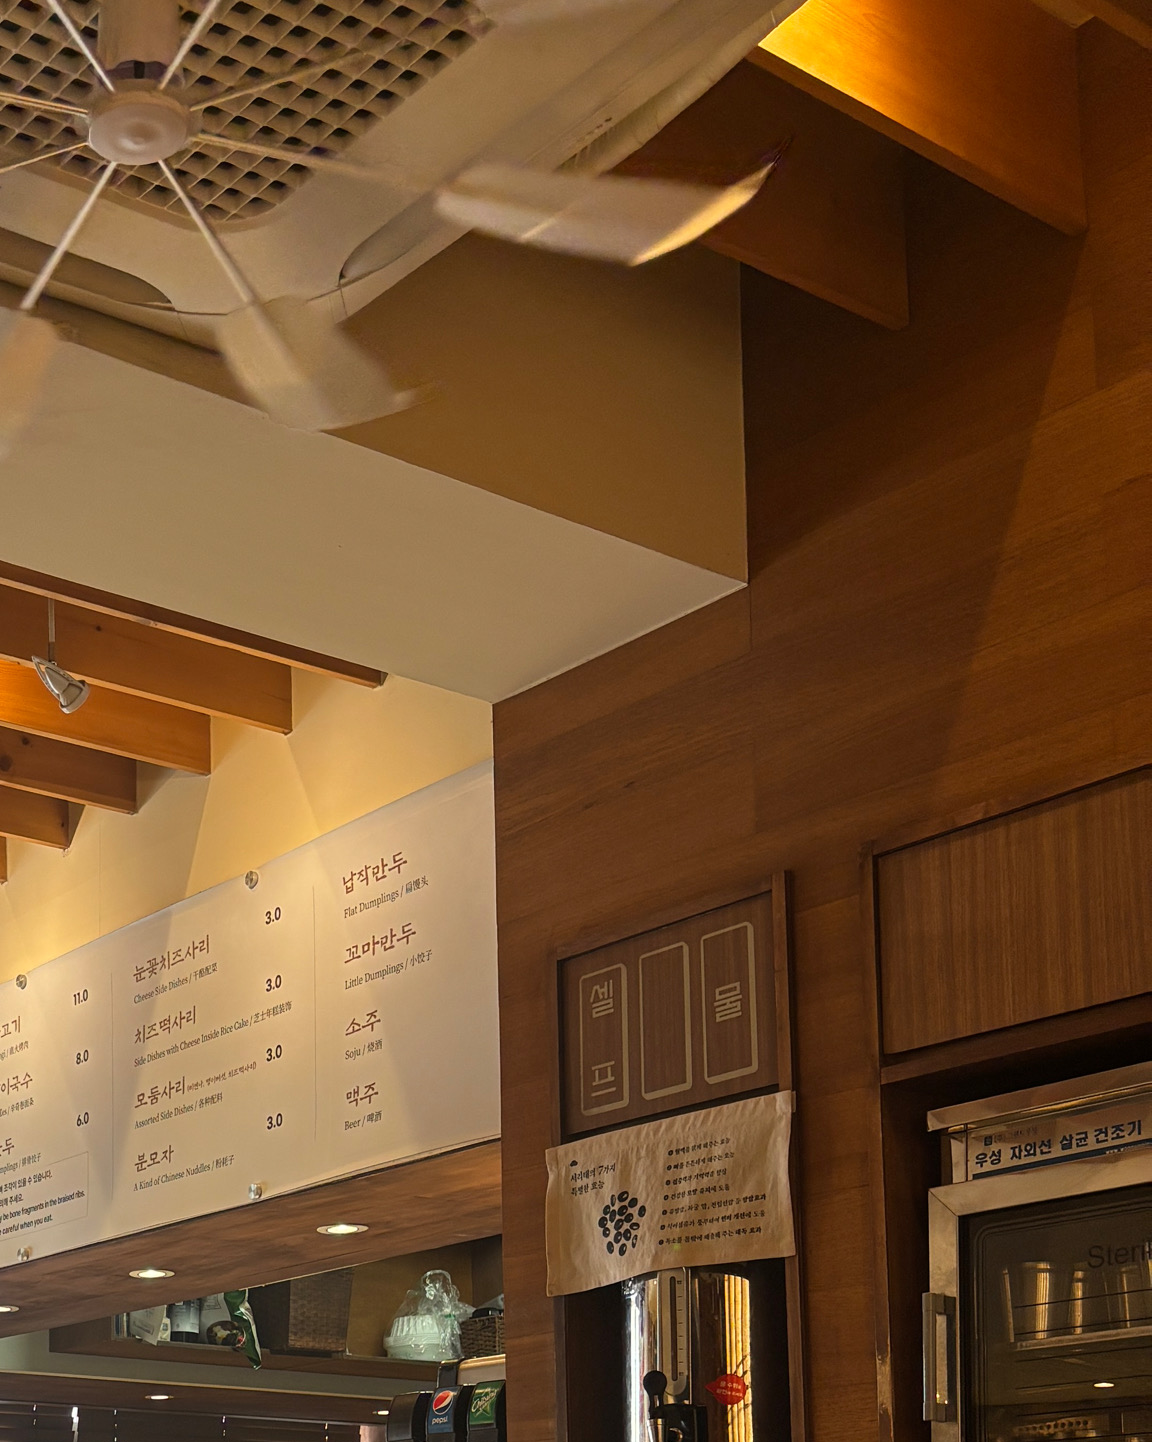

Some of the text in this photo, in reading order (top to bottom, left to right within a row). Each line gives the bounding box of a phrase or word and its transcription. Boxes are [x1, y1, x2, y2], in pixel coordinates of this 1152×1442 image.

[342, 851, 408, 895] 납작만두
[265, 907, 281, 925] 3.0
[343, 890, 399, 919] Flat Dumplings
[344, 922, 417, 964] 꼬마만두
[132, 934, 210, 983] 눈꽃치즈사리
[265, 974, 282, 993] 3.0
[344, 960, 404, 990] Little Dumplings
[73, 989, 89, 1006] 11.0
[133, 976, 188, 1005] Cheese Side Dishes
[713, 981, 743, 1023] 물
[134, 1005, 196, 1045] 치즈떡사리
[345, 1009, 381, 1036] 소주
[134, 1018, 249, 1068] Side Dishes with Cheese Inside Rice Cake
[590, 979, 616, 1097] 셀프
[76, 1049, 89, 1065] 8.0
[266, 1044, 283, 1062] 3.0
[344, 1047, 361, 1060] Soju
[134, 1076, 186, 1109] 모둠사리
[346, 1082, 379, 1107] 맥주
[76, 1112, 89, 1127] 6.0
[134, 1103, 194, 1130] Assorted Side Dishes
[266, 1113, 283, 1130] 3.0
[344, 1118, 361, 1131] Beer
[975, 1149, 1002, 1167] 우성
[1009, 1139, 1052, 1161] 자외선
[1059, 1131, 1089, 1151] 살균
[1094, 1120, 1142, 1144] 건조기
[134, 1144, 175, 1173] 분모자
[27, 1176, 33, 1185] 수
[133, 1183, 138, 1192] A
[139, 1178, 153, 1191] Kind
[154, 1175, 161, 1186] of
[160, 1169, 185, 1184] Chinese
[2, 1212, 9, 1220] be
[9, 1209, 21, 1219] bone
[21, 1202, 45, 1216] fragments
[44, 1200, 49, 1209] in
[49, 1198, 57, 1207] the
[57, 1192, 75, 1205] braised
[2, 1223, 19, 1236] careful
[20, 1220, 34, 1231] when
[33, 1217, 43, 1229] you
[431, 1416, 448, 1426] pepsi
